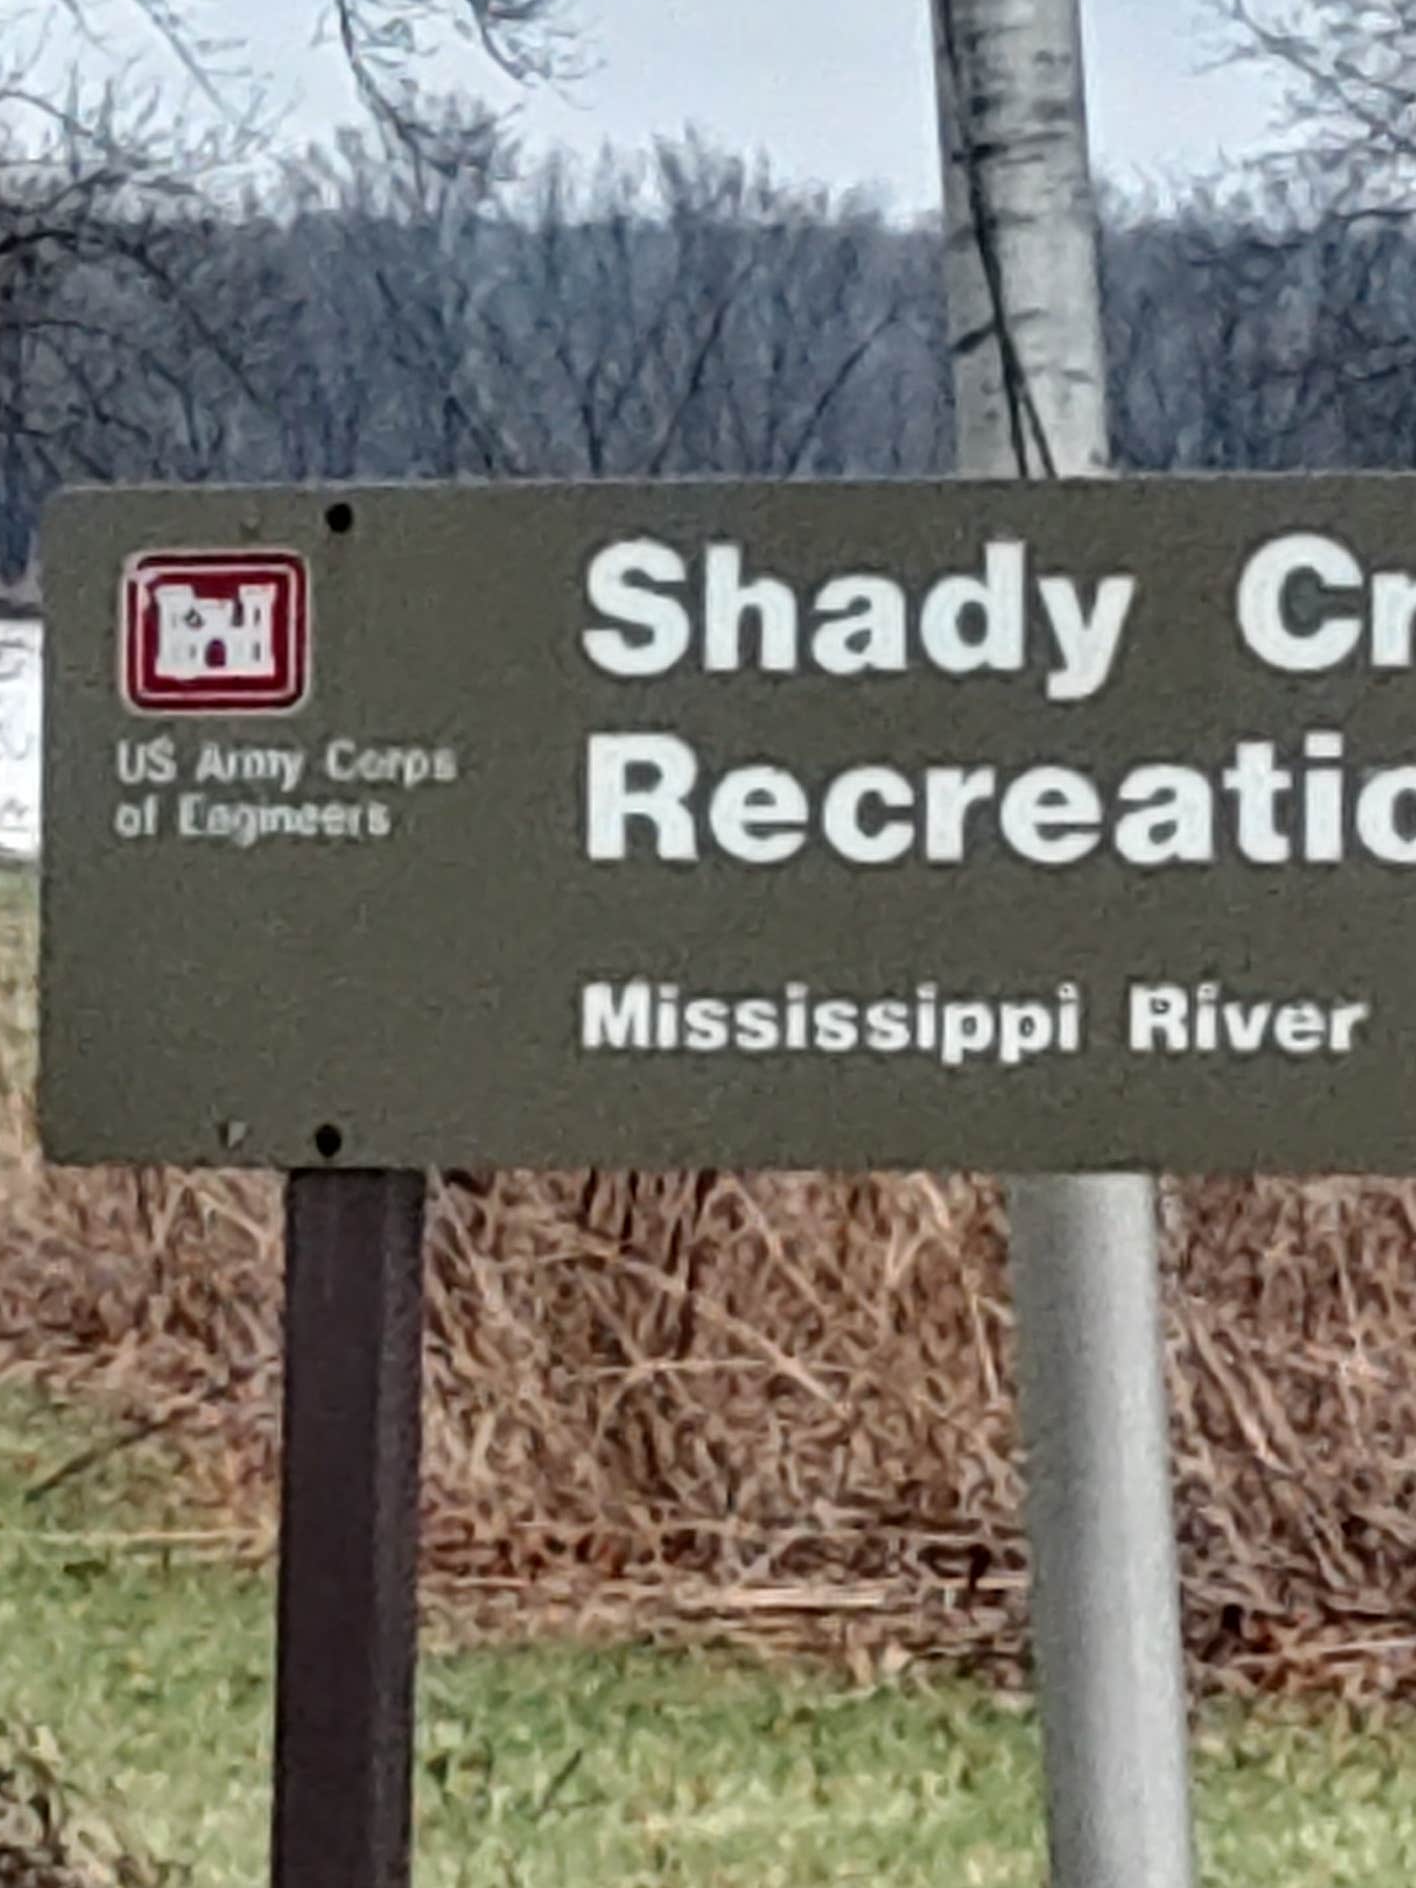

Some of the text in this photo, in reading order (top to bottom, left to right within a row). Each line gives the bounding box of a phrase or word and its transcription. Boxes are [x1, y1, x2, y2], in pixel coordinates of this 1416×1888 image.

[581, 536, 1137, 701] Shady
[117, 735, 459, 792] US Army Corps
[113, 792, 392, 847] of Engineers
[581, 979, 1370, 1067] Mississippi River
